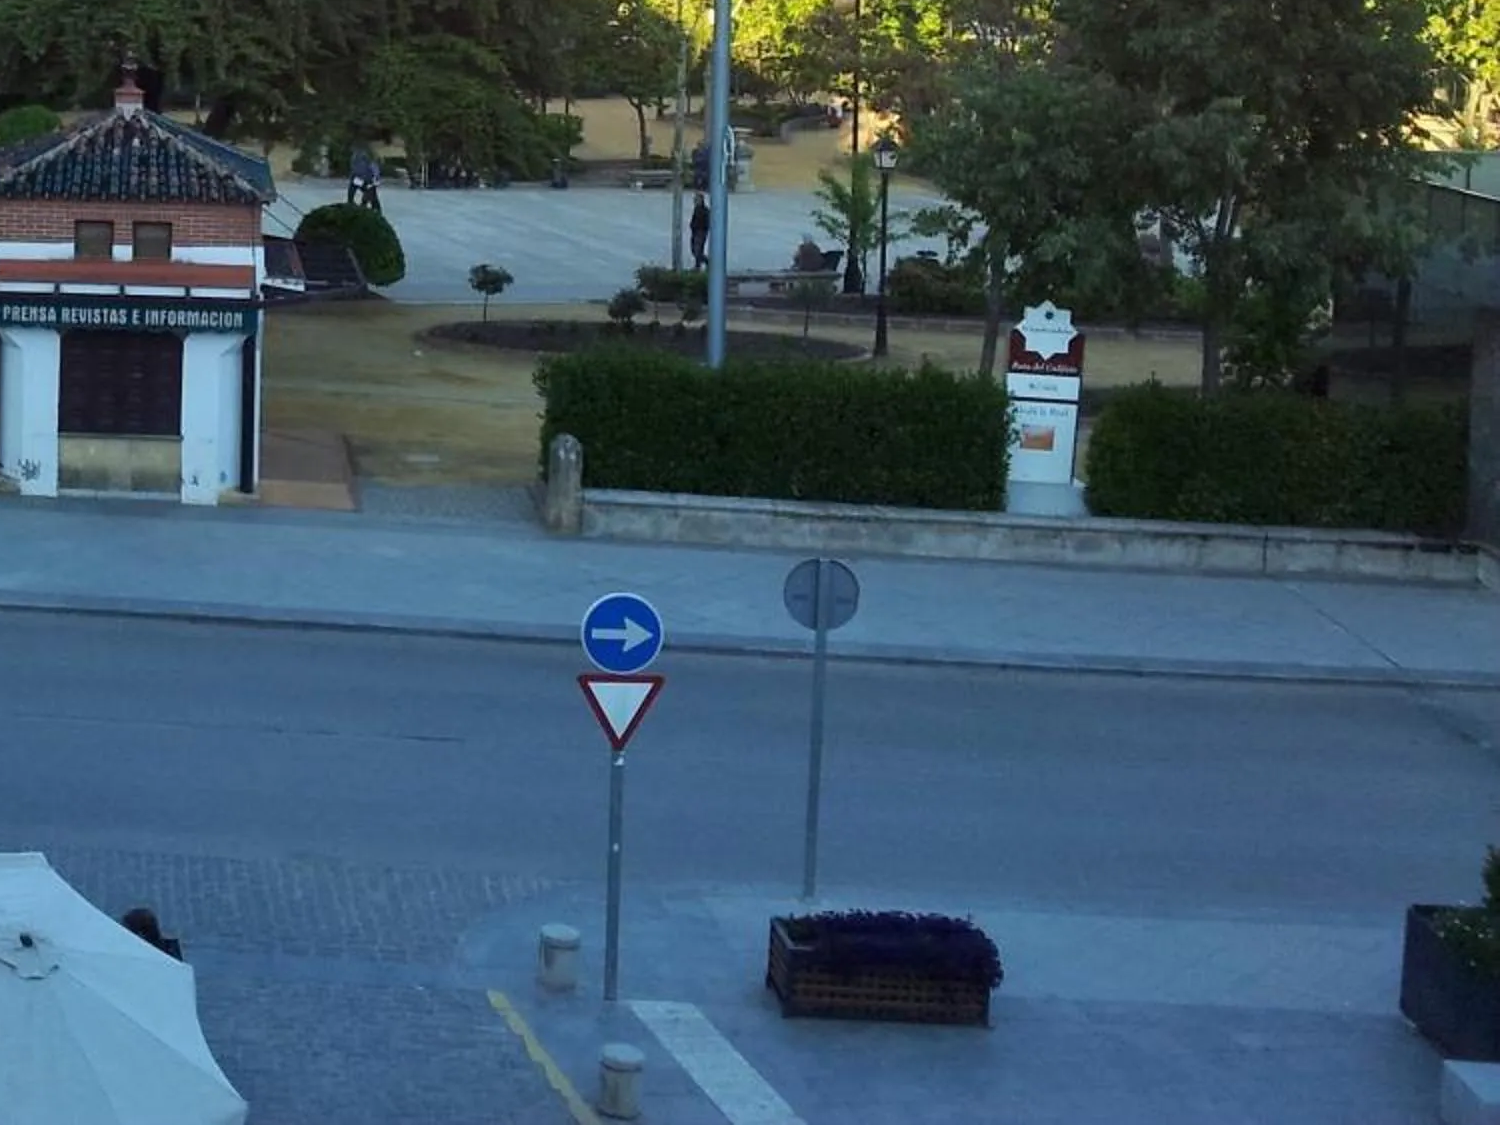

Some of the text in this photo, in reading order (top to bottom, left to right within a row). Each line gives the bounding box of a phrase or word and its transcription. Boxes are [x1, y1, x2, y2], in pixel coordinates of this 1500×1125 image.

[2, 305, 243, 328] PRENSA REVISTAS E INFORMACION
